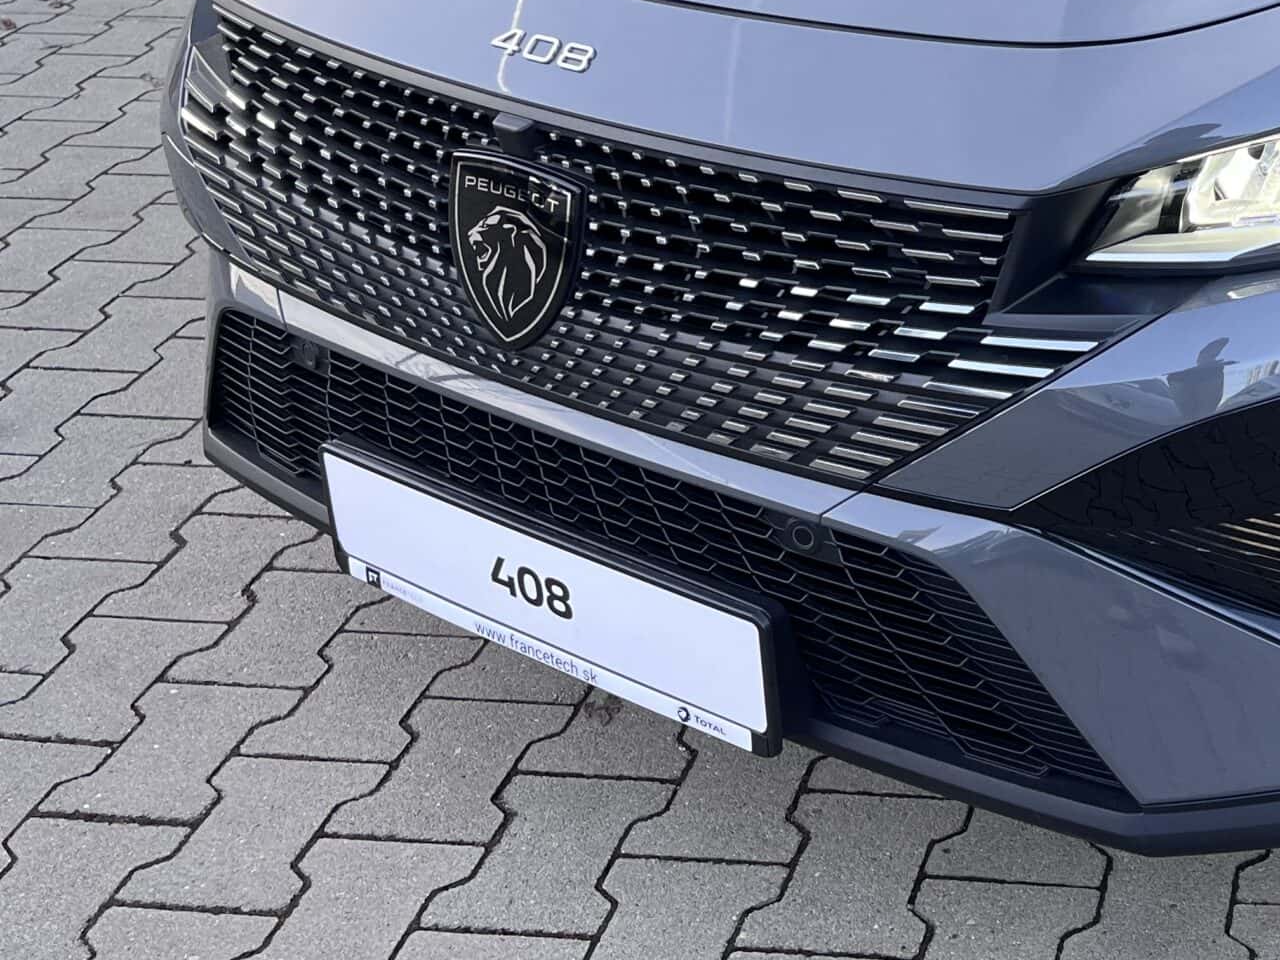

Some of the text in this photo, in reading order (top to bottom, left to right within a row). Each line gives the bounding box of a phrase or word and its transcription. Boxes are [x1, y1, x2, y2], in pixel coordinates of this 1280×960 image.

[490, 28, 597, 73] 408
[464, 175, 560, 213] PEUGEOT
[490, 556, 574, 621] 408
[473, 622, 599, 686] wwwfrancetechsk
[694, 714, 728, 736] TOTAL
